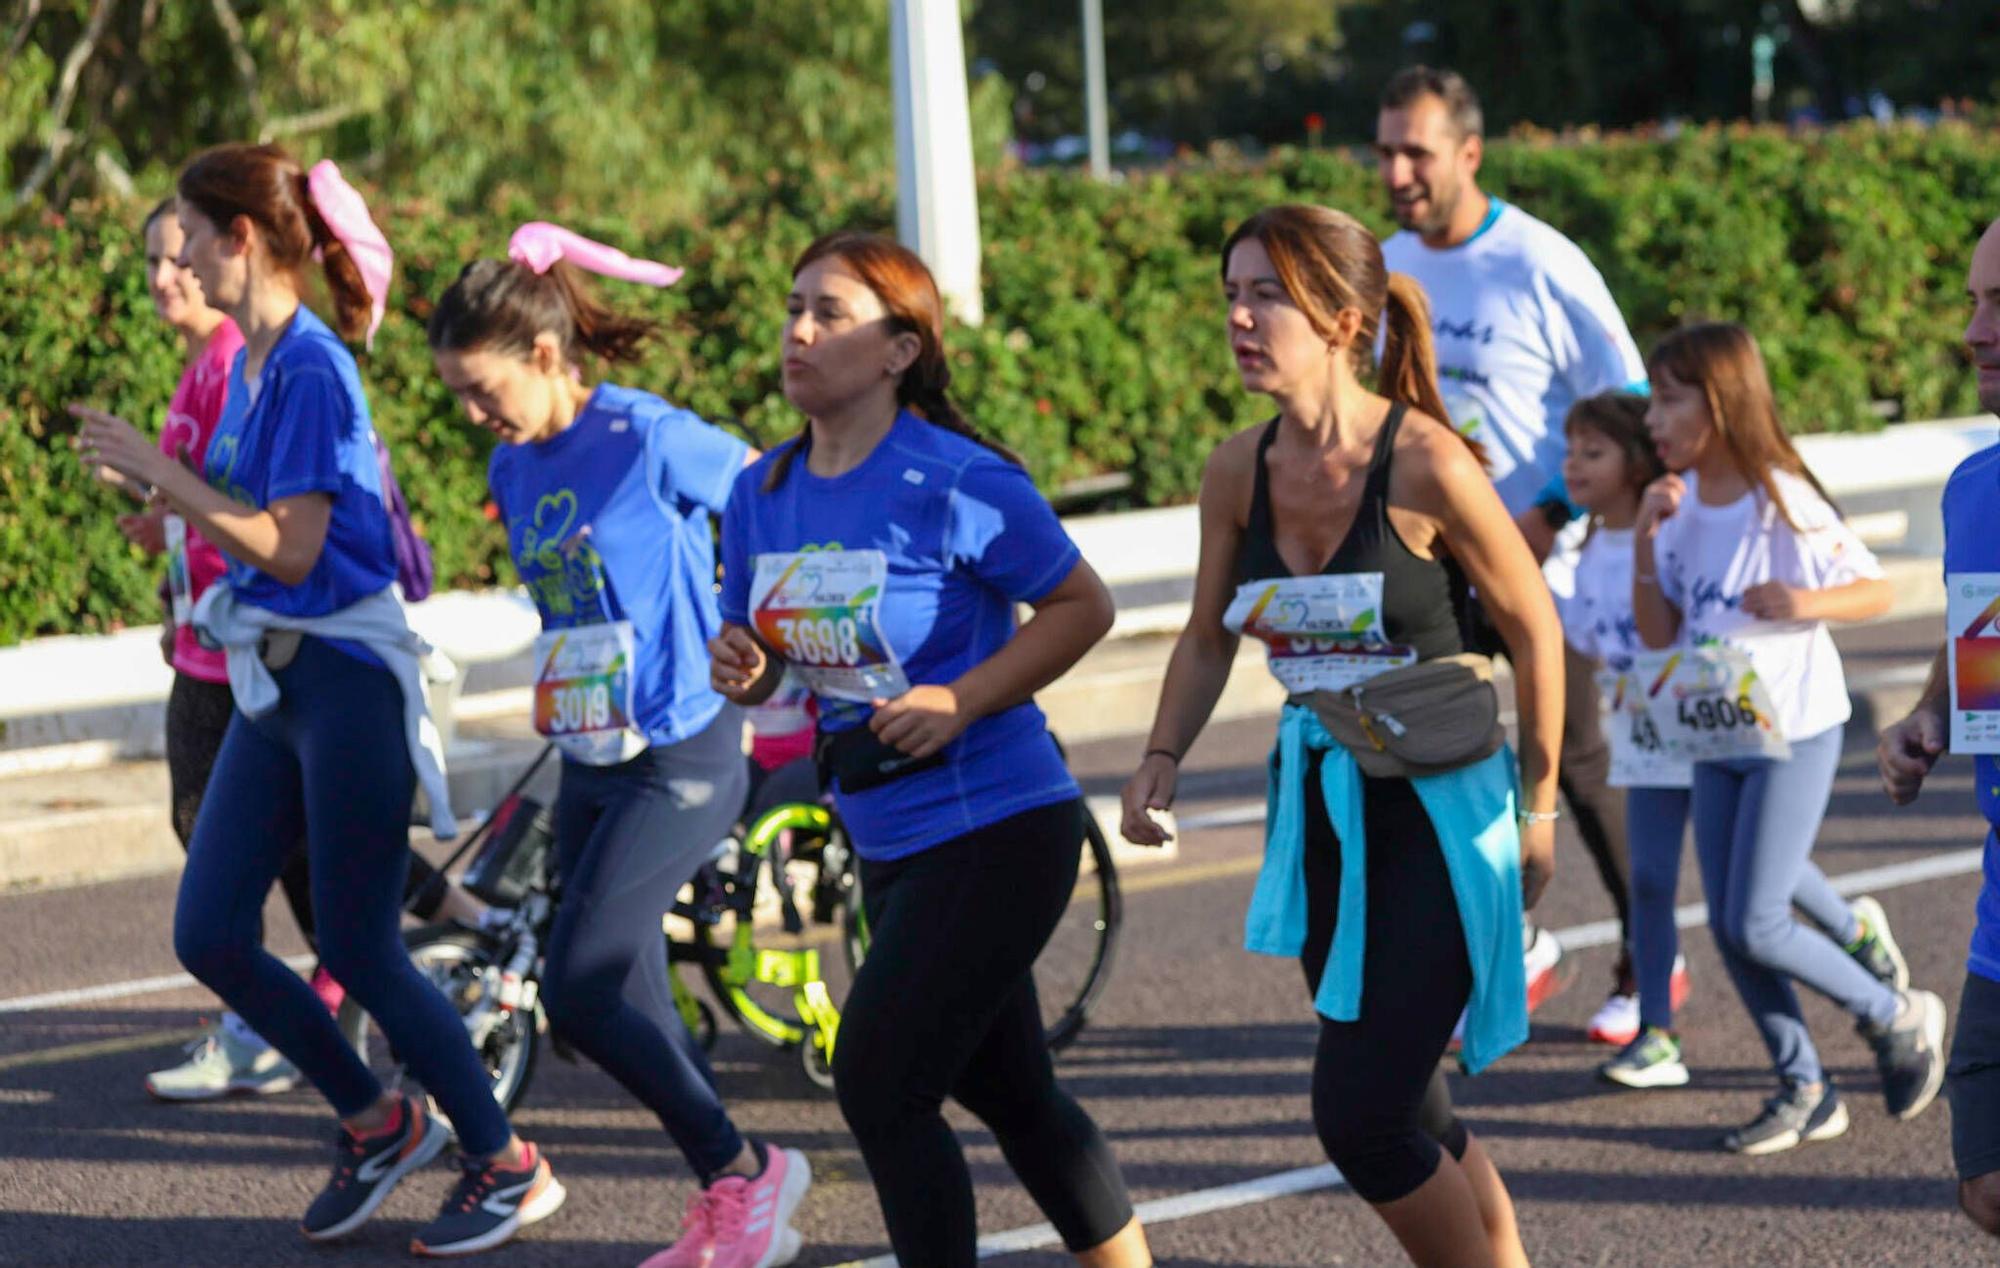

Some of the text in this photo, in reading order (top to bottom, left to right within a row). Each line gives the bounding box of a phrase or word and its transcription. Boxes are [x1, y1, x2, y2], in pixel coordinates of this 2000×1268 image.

[776, 616, 861, 666] 3698
[550, 682, 610, 733] 3019
[1678, 694, 1757, 731] 4906
